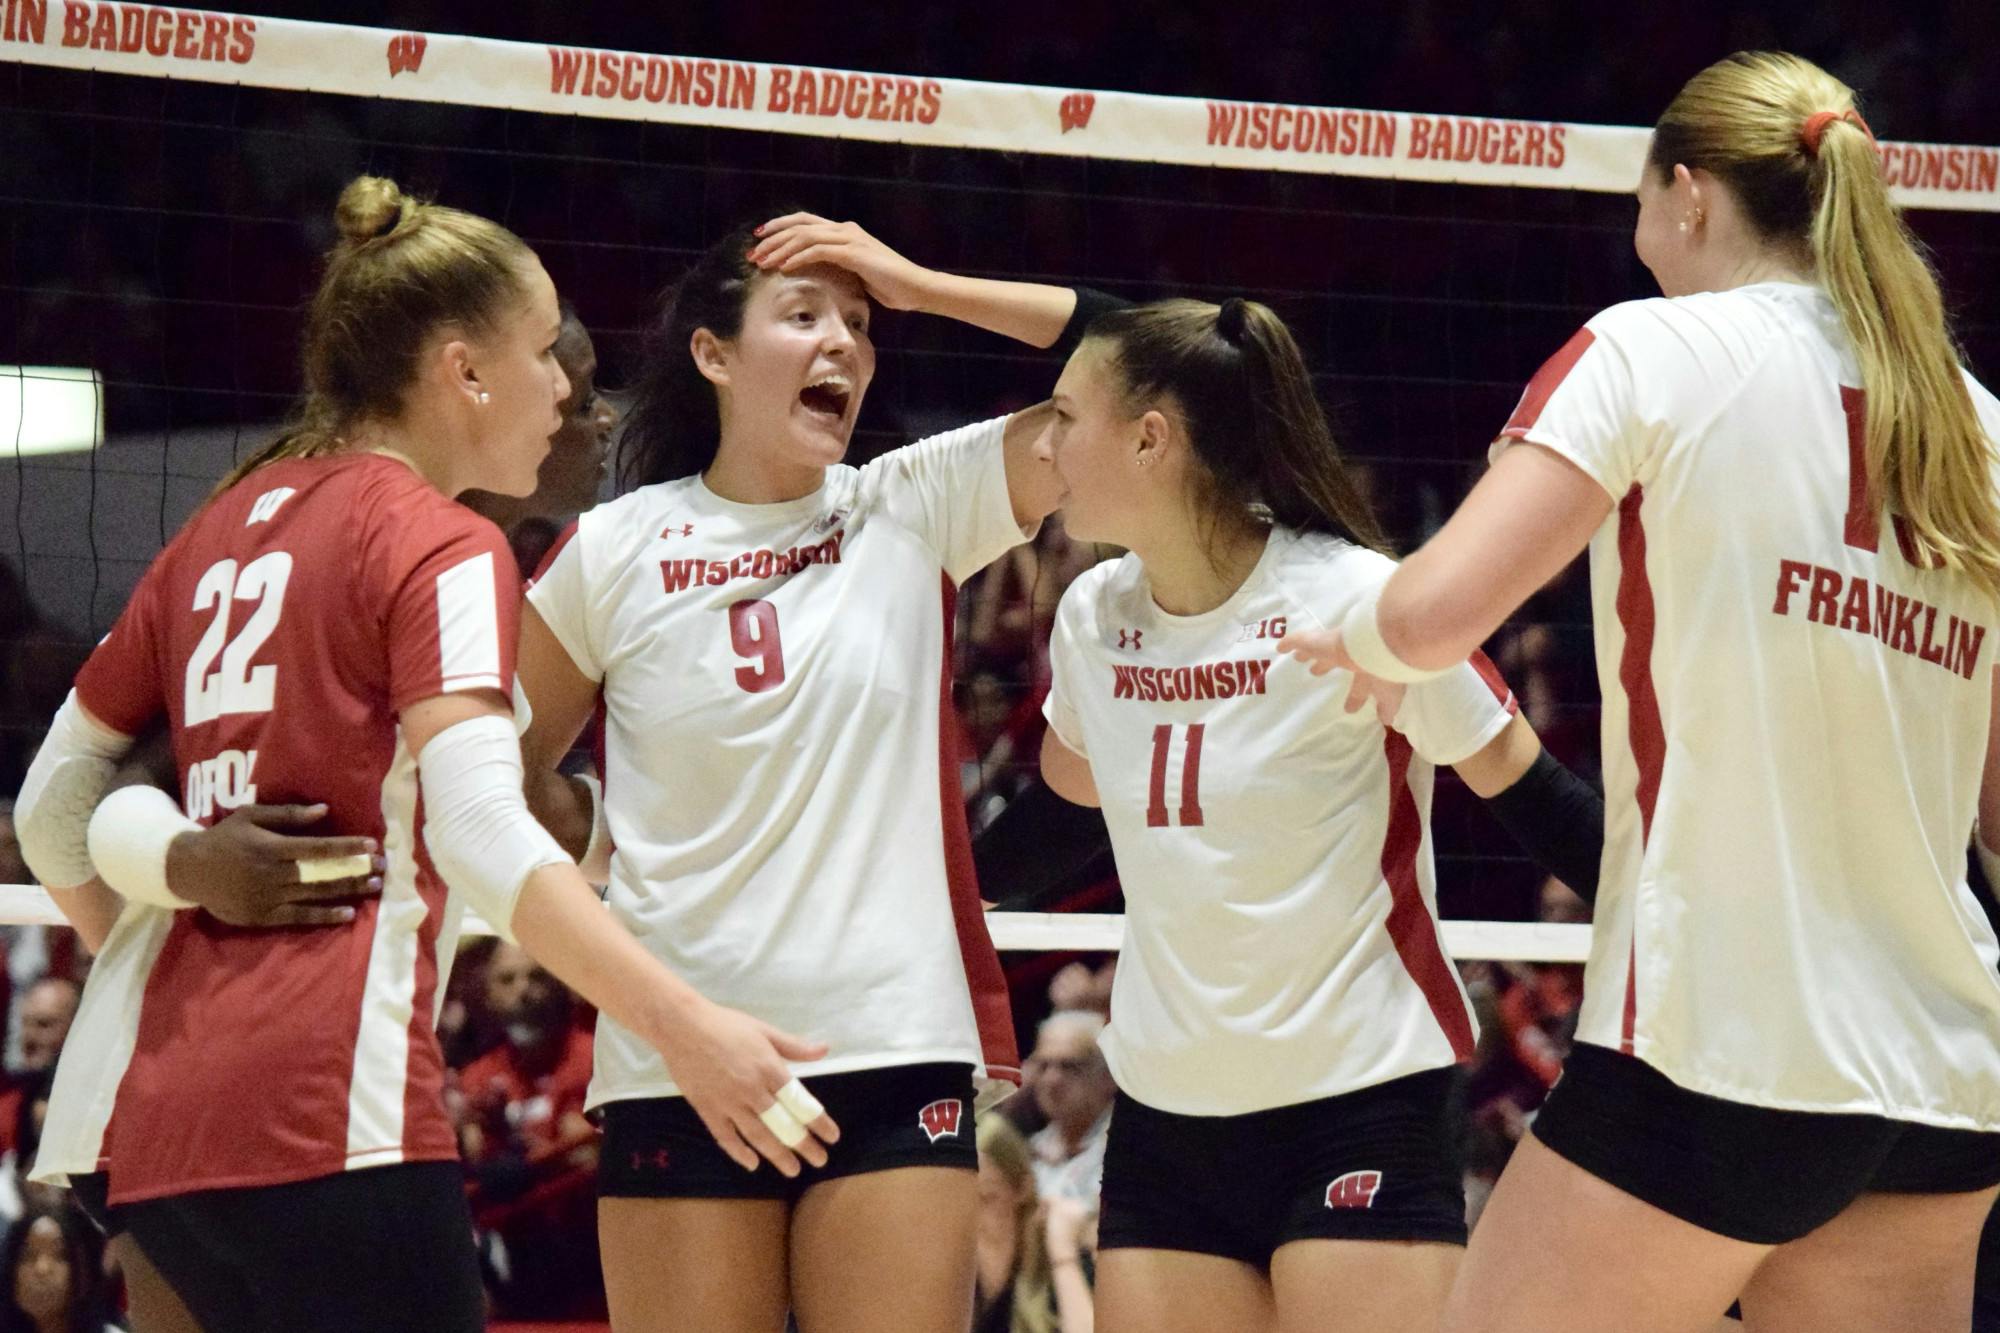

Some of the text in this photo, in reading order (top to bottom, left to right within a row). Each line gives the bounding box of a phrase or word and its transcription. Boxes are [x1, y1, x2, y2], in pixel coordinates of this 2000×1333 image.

[0, 0, 256, 64] IN BADGERS
[548, 46, 942, 125] WISCONSIN BADGERS
[1206, 101, 1566, 169] WISCONSIN BADGERS
[1880, 144, 1999, 193] CONSIN
[185, 551, 293, 727] 22
[729, 598, 785, 693] 9
[1772, 559, 1986, 680] FRANKLIN
[1112, 659, 1271, 702] WISCONSIN
[1146, 723, 1205, 827] 11
